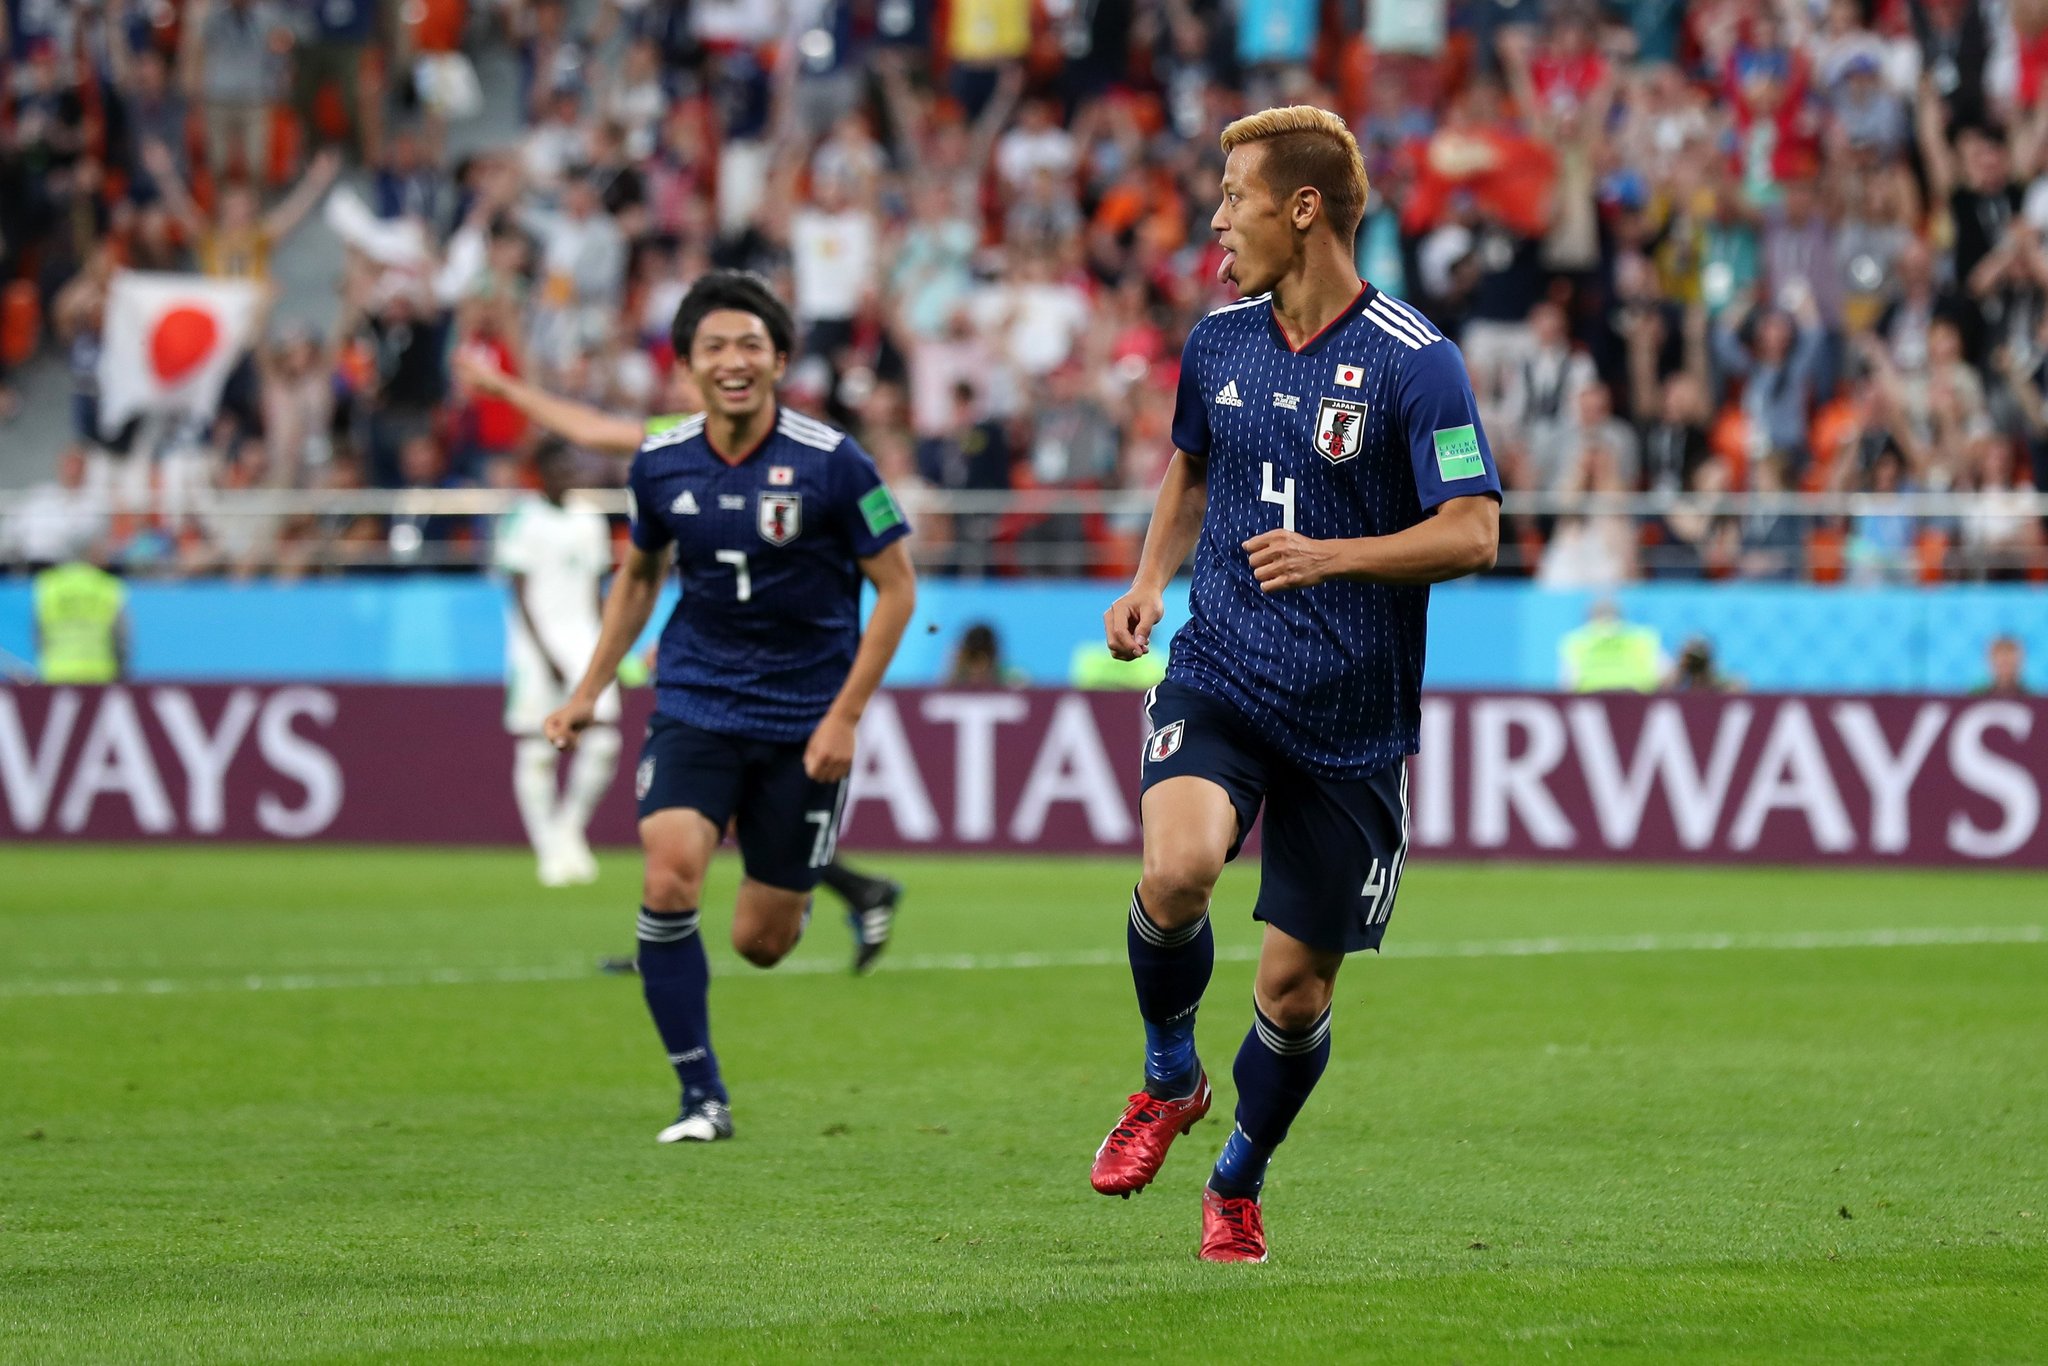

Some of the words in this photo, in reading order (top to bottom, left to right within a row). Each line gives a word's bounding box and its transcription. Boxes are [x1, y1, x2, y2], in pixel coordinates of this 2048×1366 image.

[1215, 395, 1242, 408] adidas
[1331, 402, 1356, 411] JAPAN
[1466, 456, 1481, 464] FIFA
[1261, 461, 1295, 533] 4
[714, 549, 751, 602] 7
[840, 694, 1150, 844] ATA
[1413, 697, 2041, 859] IRWAYS
[805, 810, 831, 869] 7
[1361, 858, 1386, 926] 4
